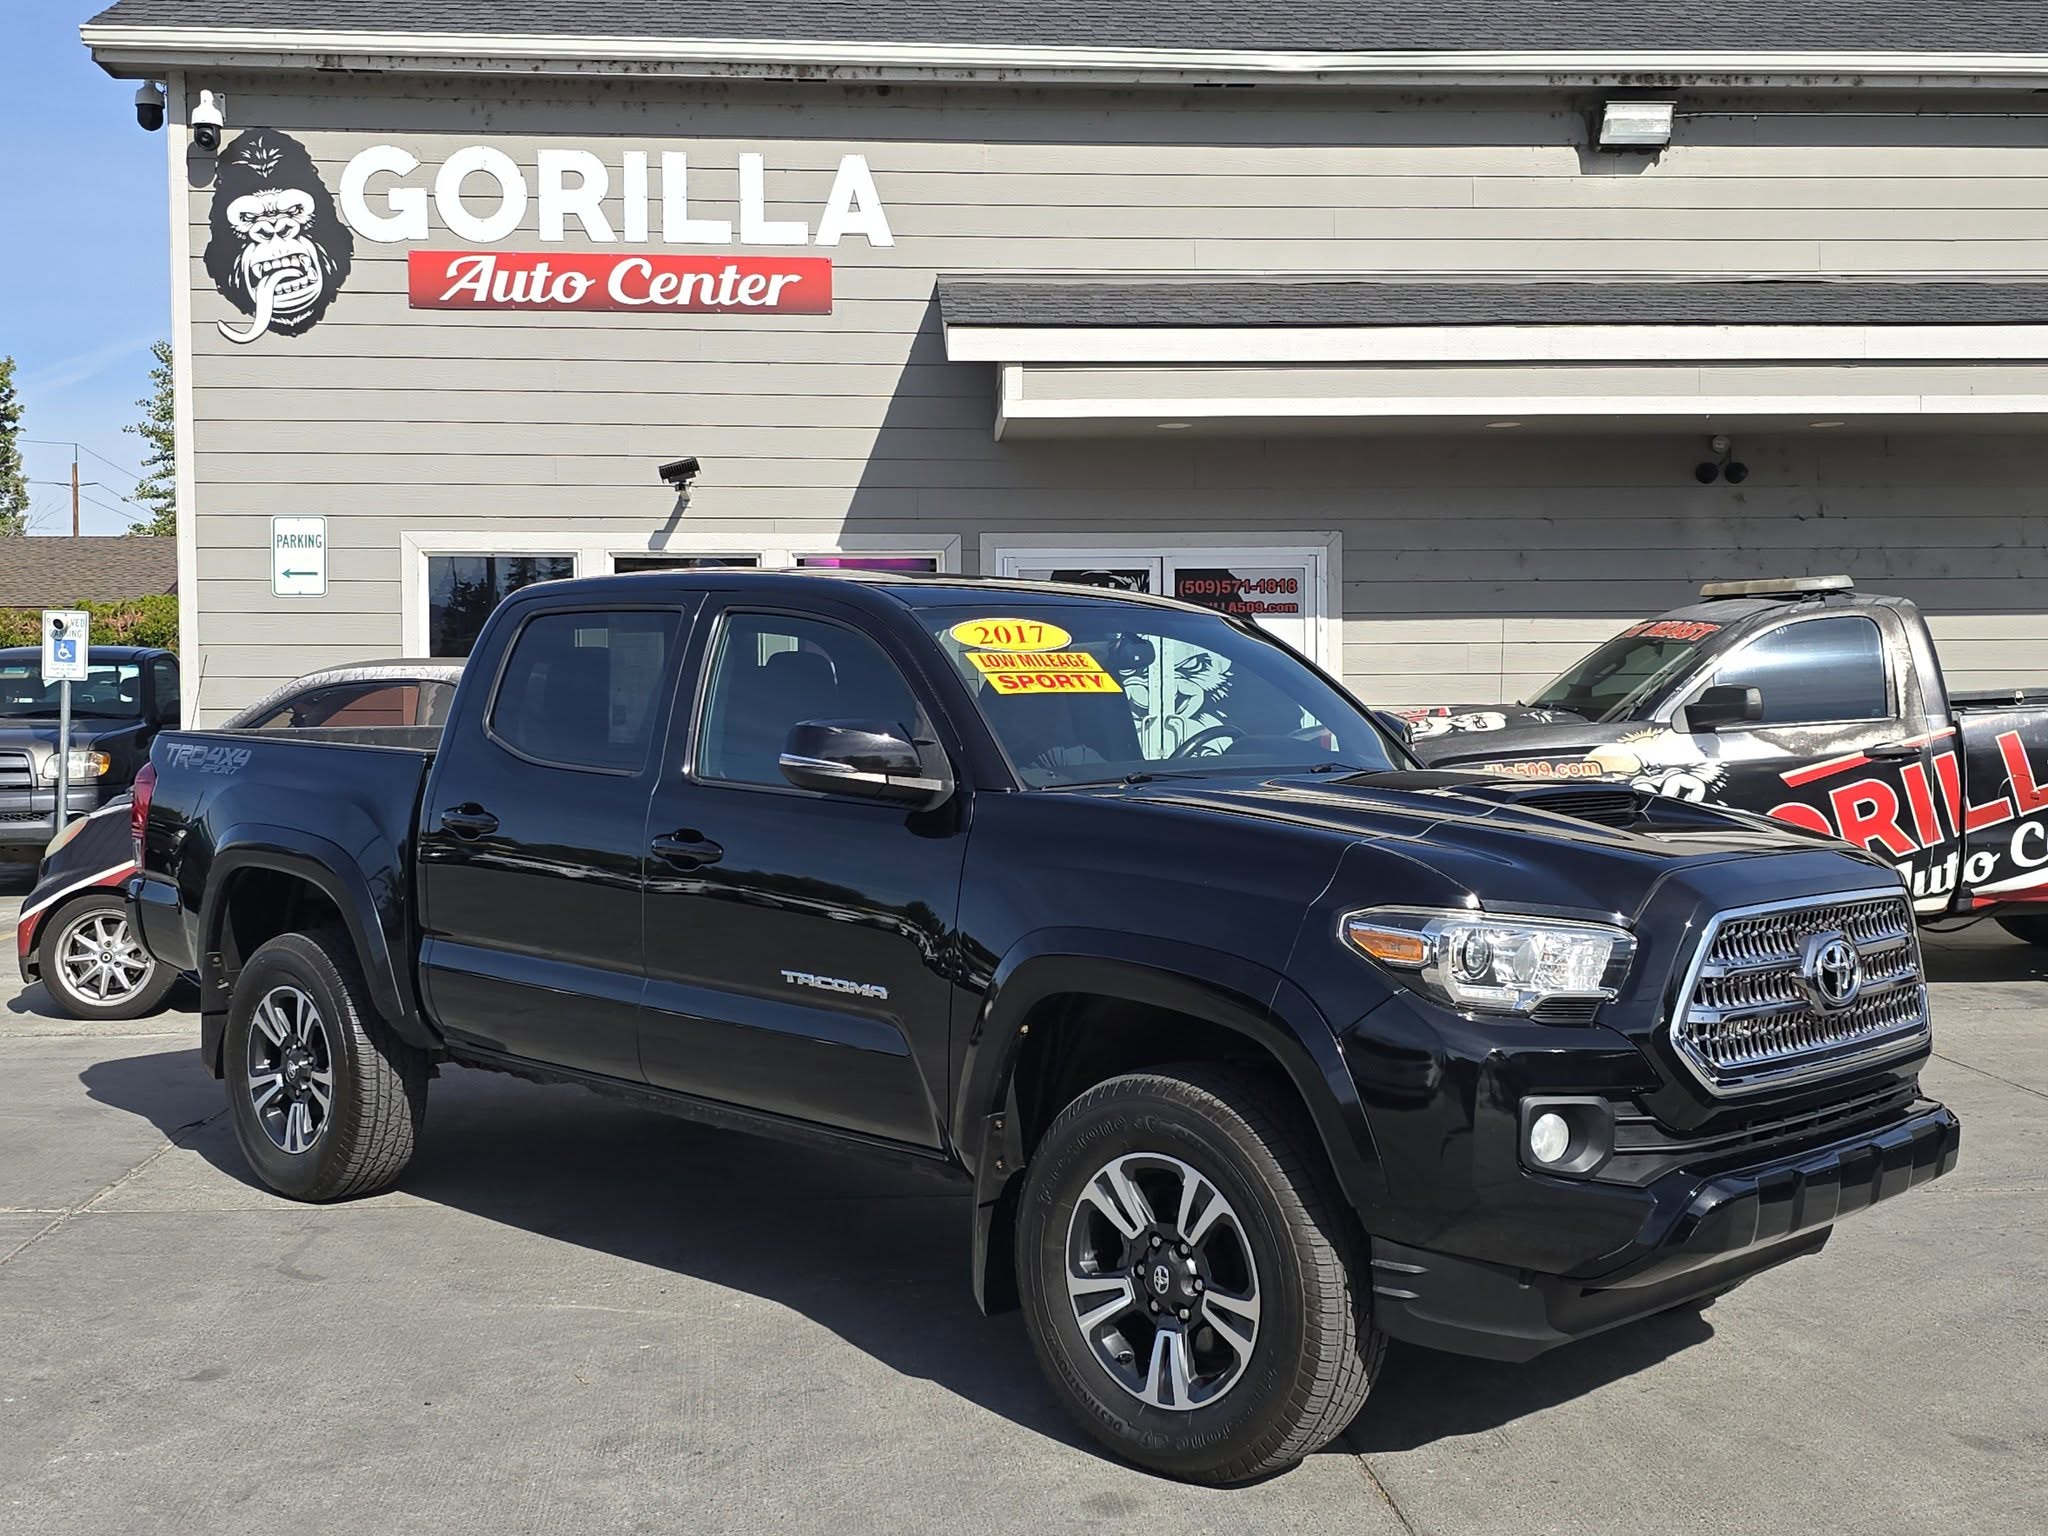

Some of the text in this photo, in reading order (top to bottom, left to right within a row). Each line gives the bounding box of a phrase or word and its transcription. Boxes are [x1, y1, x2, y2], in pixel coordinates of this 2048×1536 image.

[339, 144, 896, 247] GORILLA
[438, 254, 803, 306] Auto Center
[276, 533, 323, 549] PARKING
[1179, 578, 1299, 598] (509)571-1818
[974, 625, 1043, 645] 2017
[977, 653, 1090, 669] LOW MILEAGE
[997, 674, 1104, 690] SPORTY
[199, 763, 242, 775] SPORT
[780, 969, 888, 1000] TACOMA
